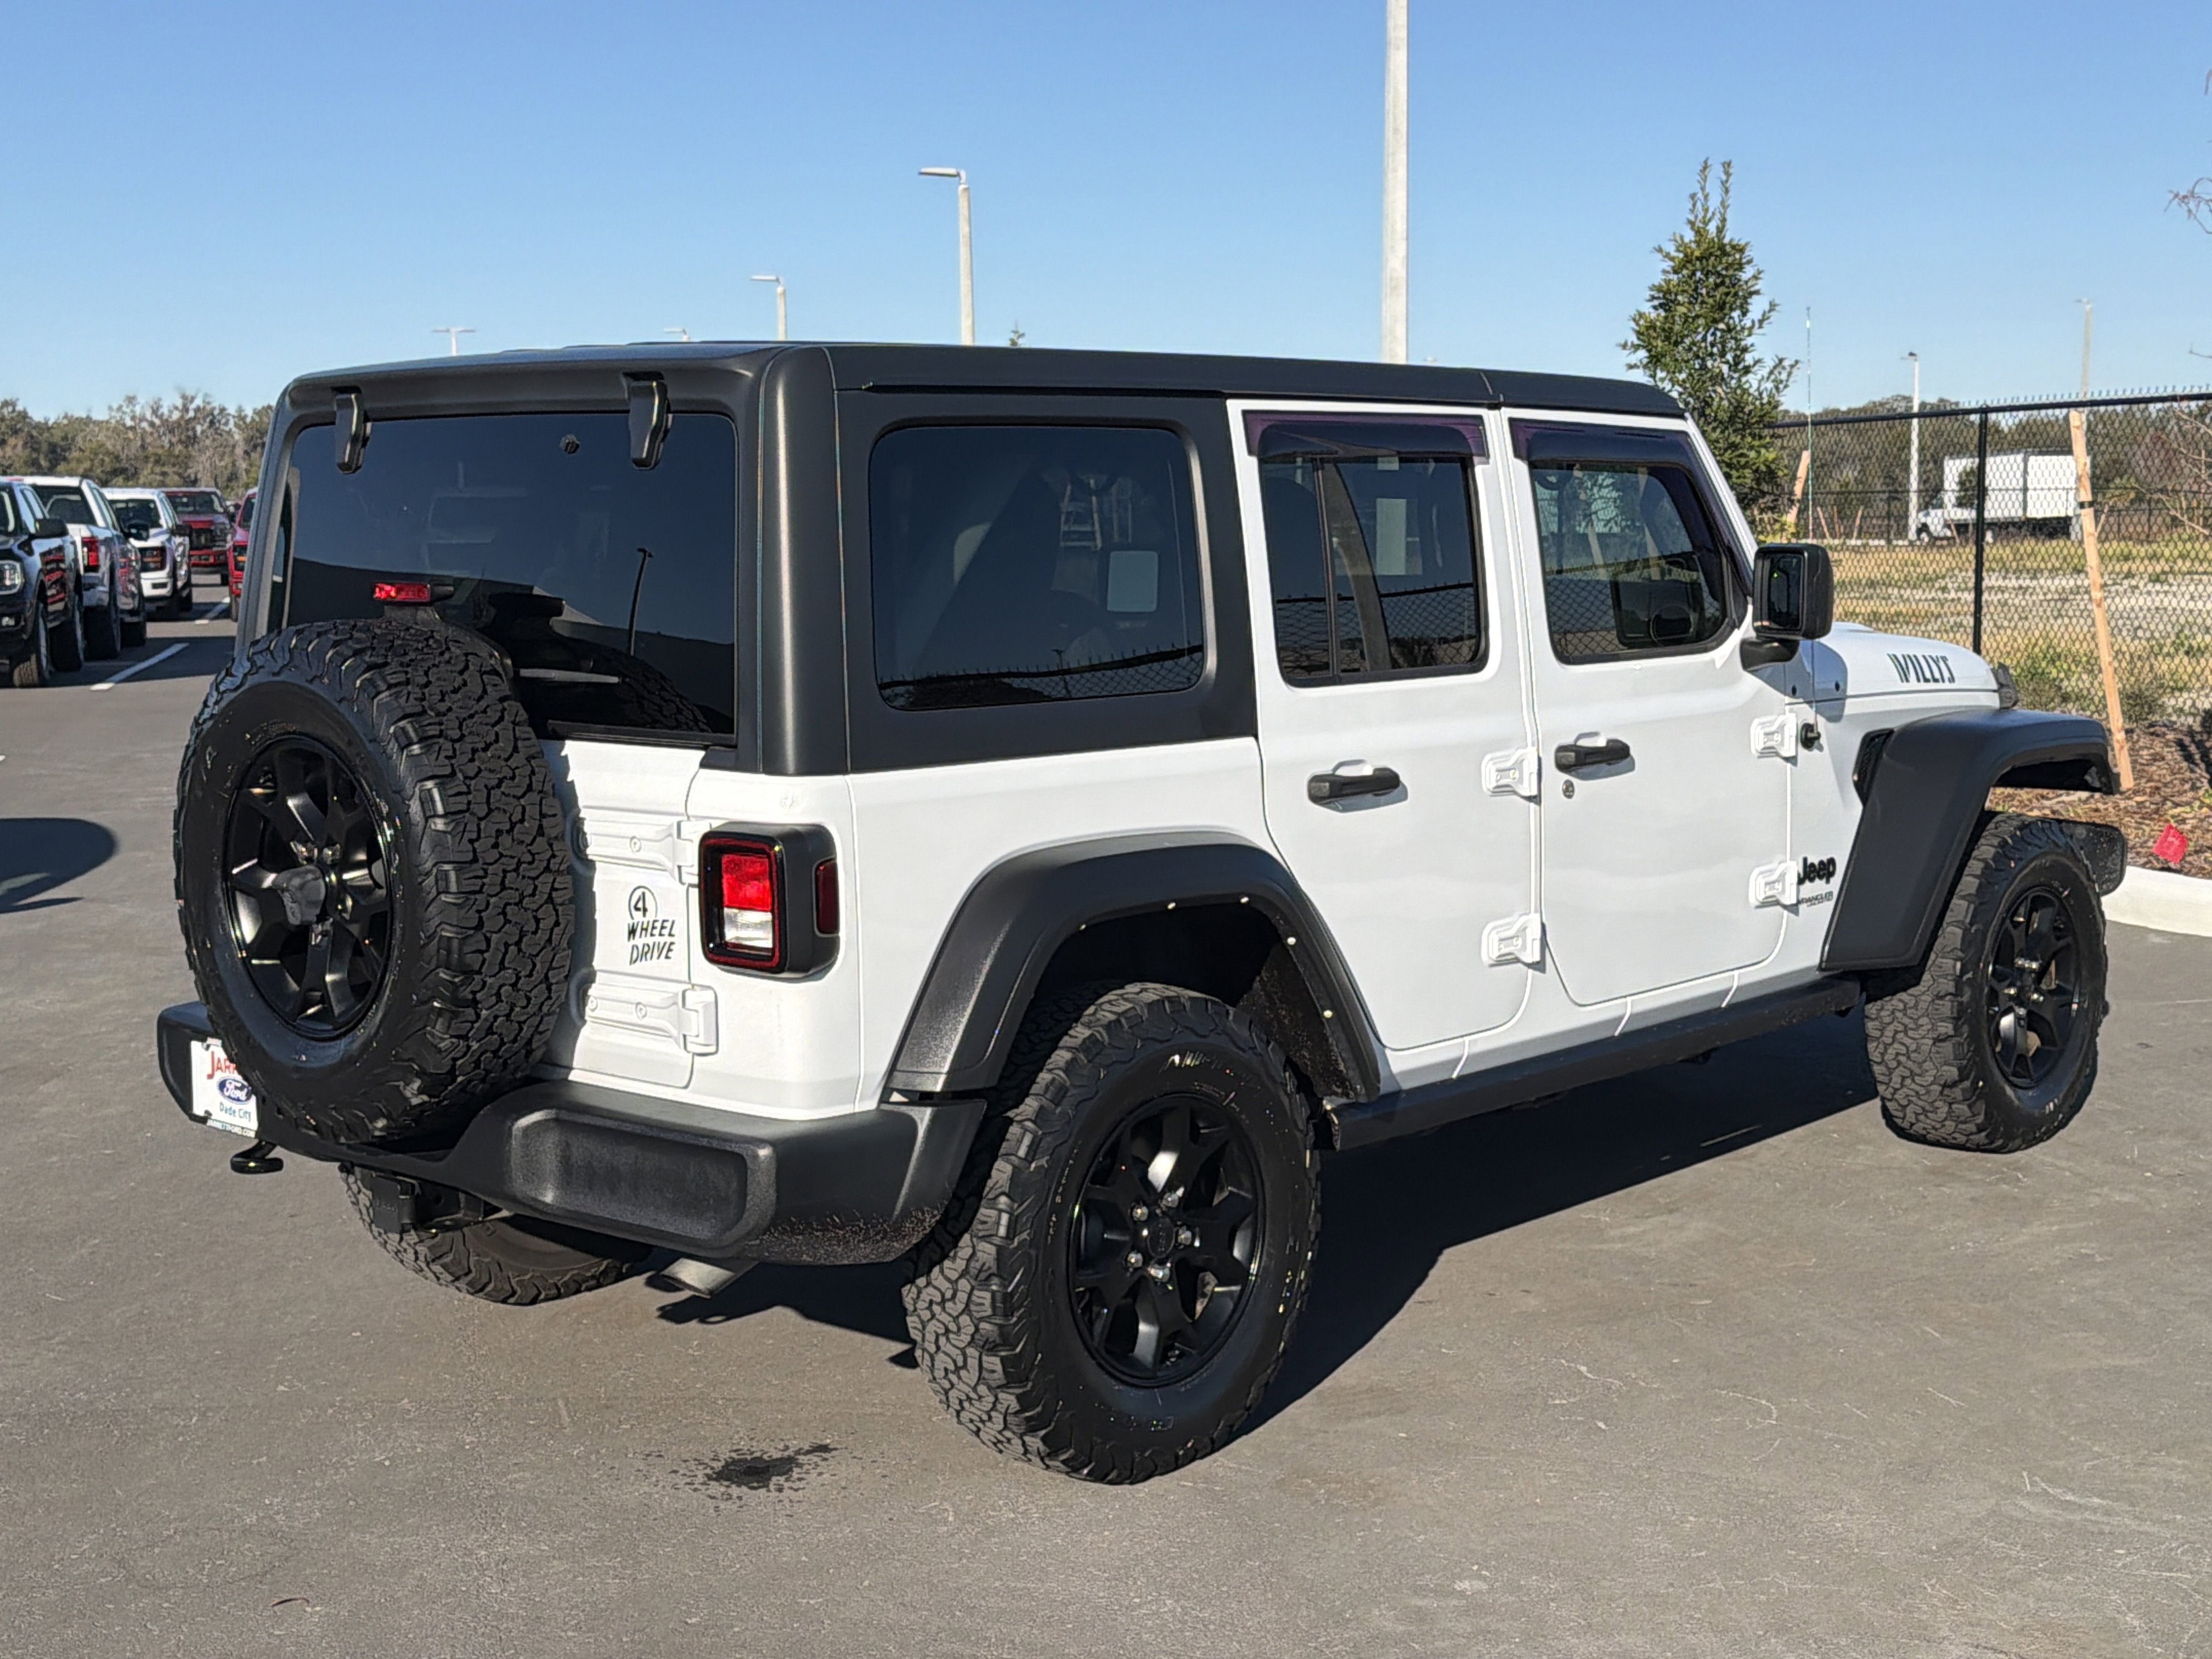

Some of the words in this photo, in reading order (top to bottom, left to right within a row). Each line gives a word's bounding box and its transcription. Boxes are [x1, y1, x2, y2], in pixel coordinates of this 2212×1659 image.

[1886, 653, 1956, 684] WILLYS
[1798, 856, 1836, 885] Jeep
[633, 891, 648, 918] 4
[627, 919, 676, 943] WHEEL
[629, 941, 676, 966] DRIVE
